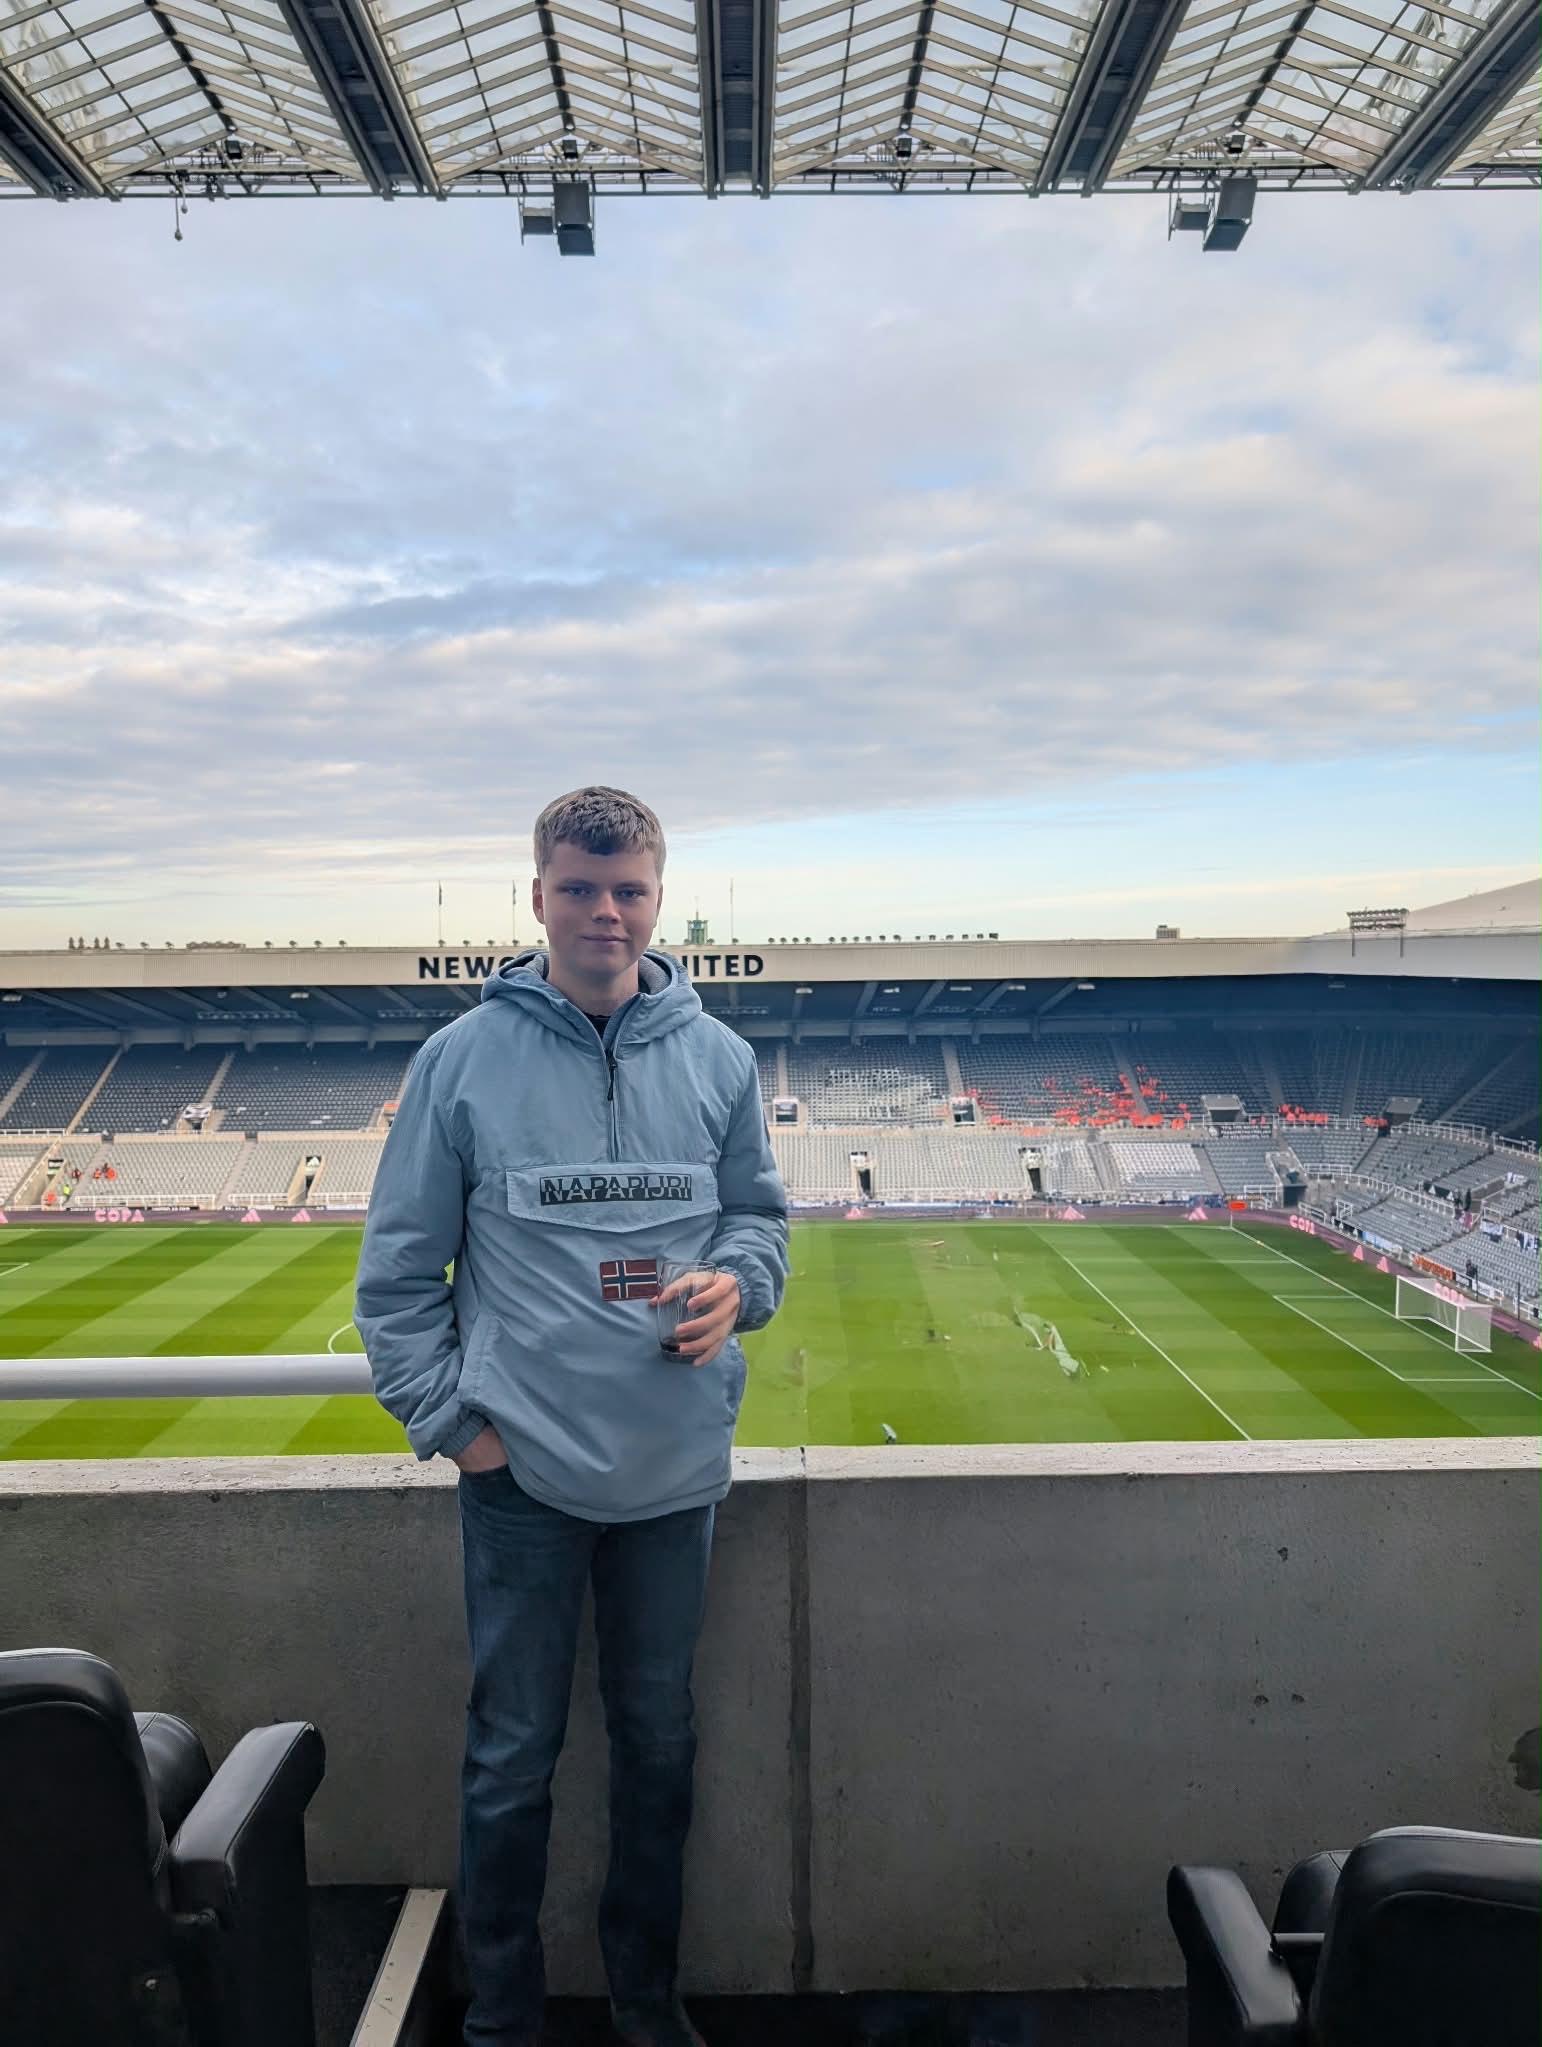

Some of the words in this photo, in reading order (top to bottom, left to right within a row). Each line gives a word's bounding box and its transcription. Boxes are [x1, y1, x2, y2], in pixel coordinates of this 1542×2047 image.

[682, 955, 763, 977] ITED
[543, 1175, 689, 1202] NAPAPIJRI
[95, 1208, 144, 1222] COPA
